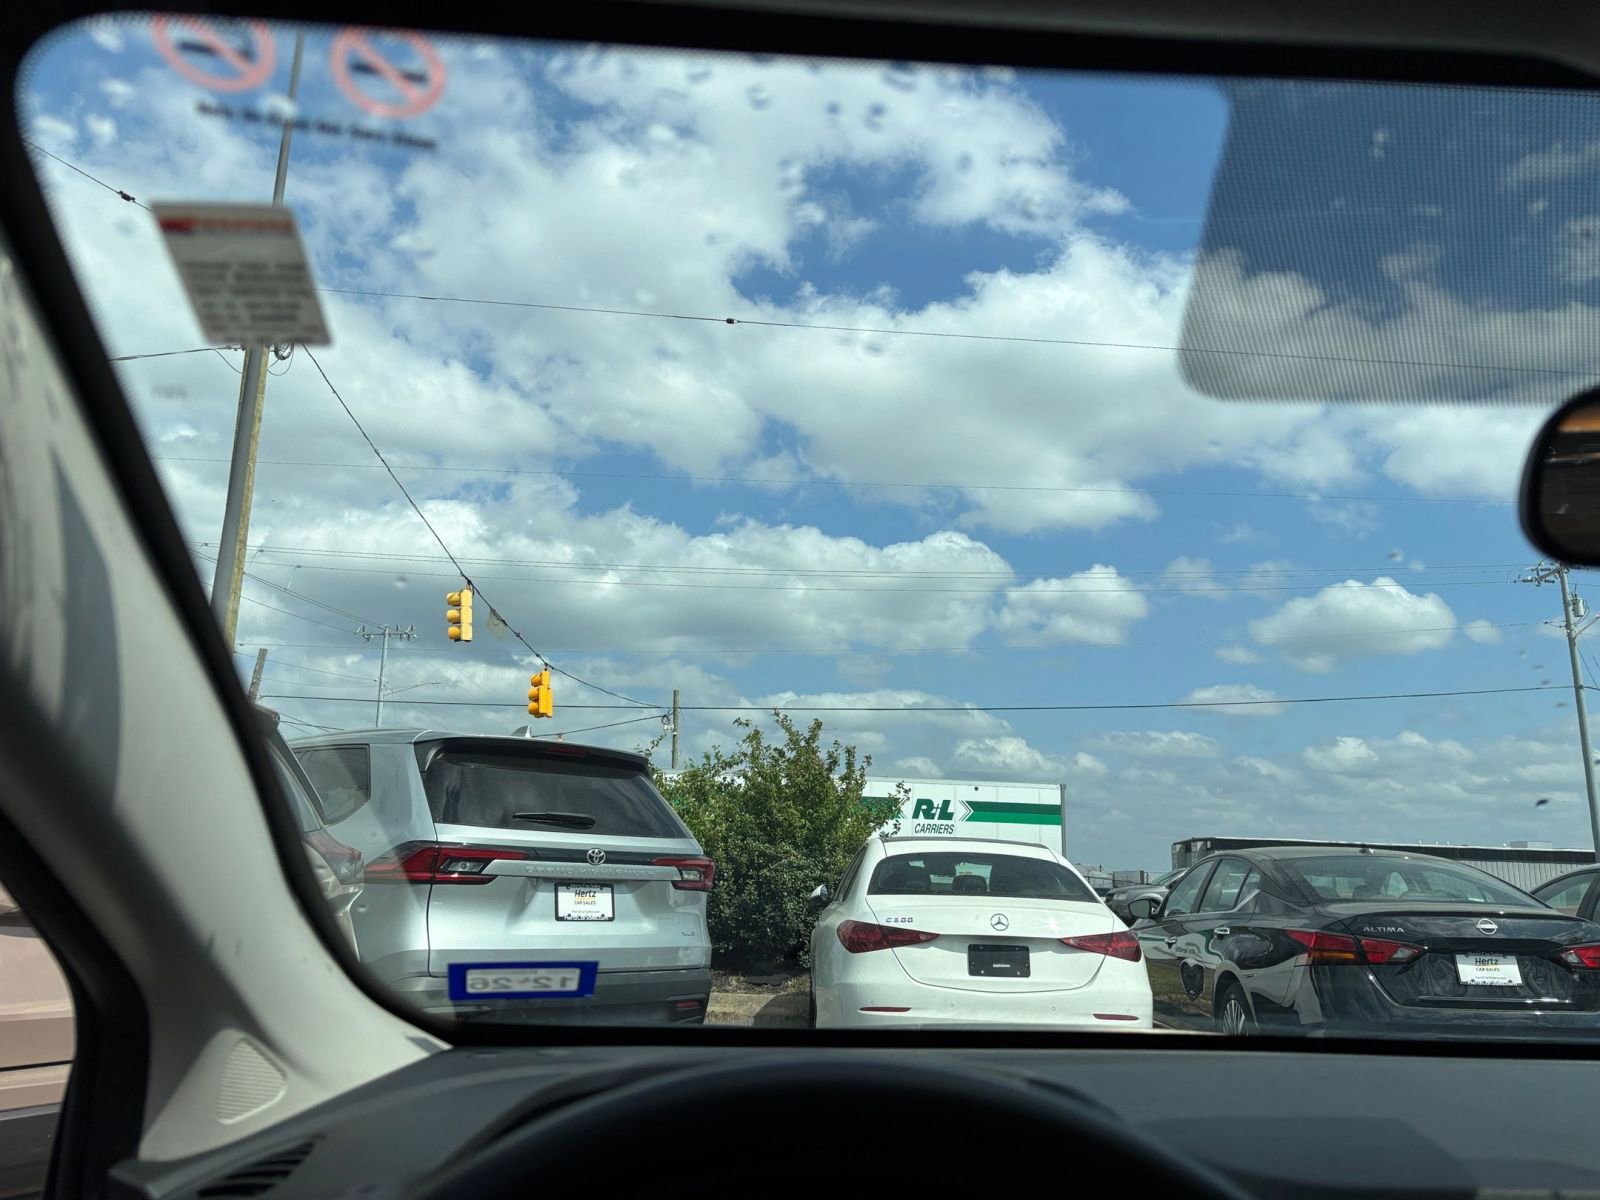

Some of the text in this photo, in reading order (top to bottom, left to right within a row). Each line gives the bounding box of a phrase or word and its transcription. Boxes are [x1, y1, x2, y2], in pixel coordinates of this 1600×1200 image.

[914, 823, 955, 835] CARRIERS
[574, 889, 597, 898] Hertz
[1475, 957, 1499, 965] Hertz
